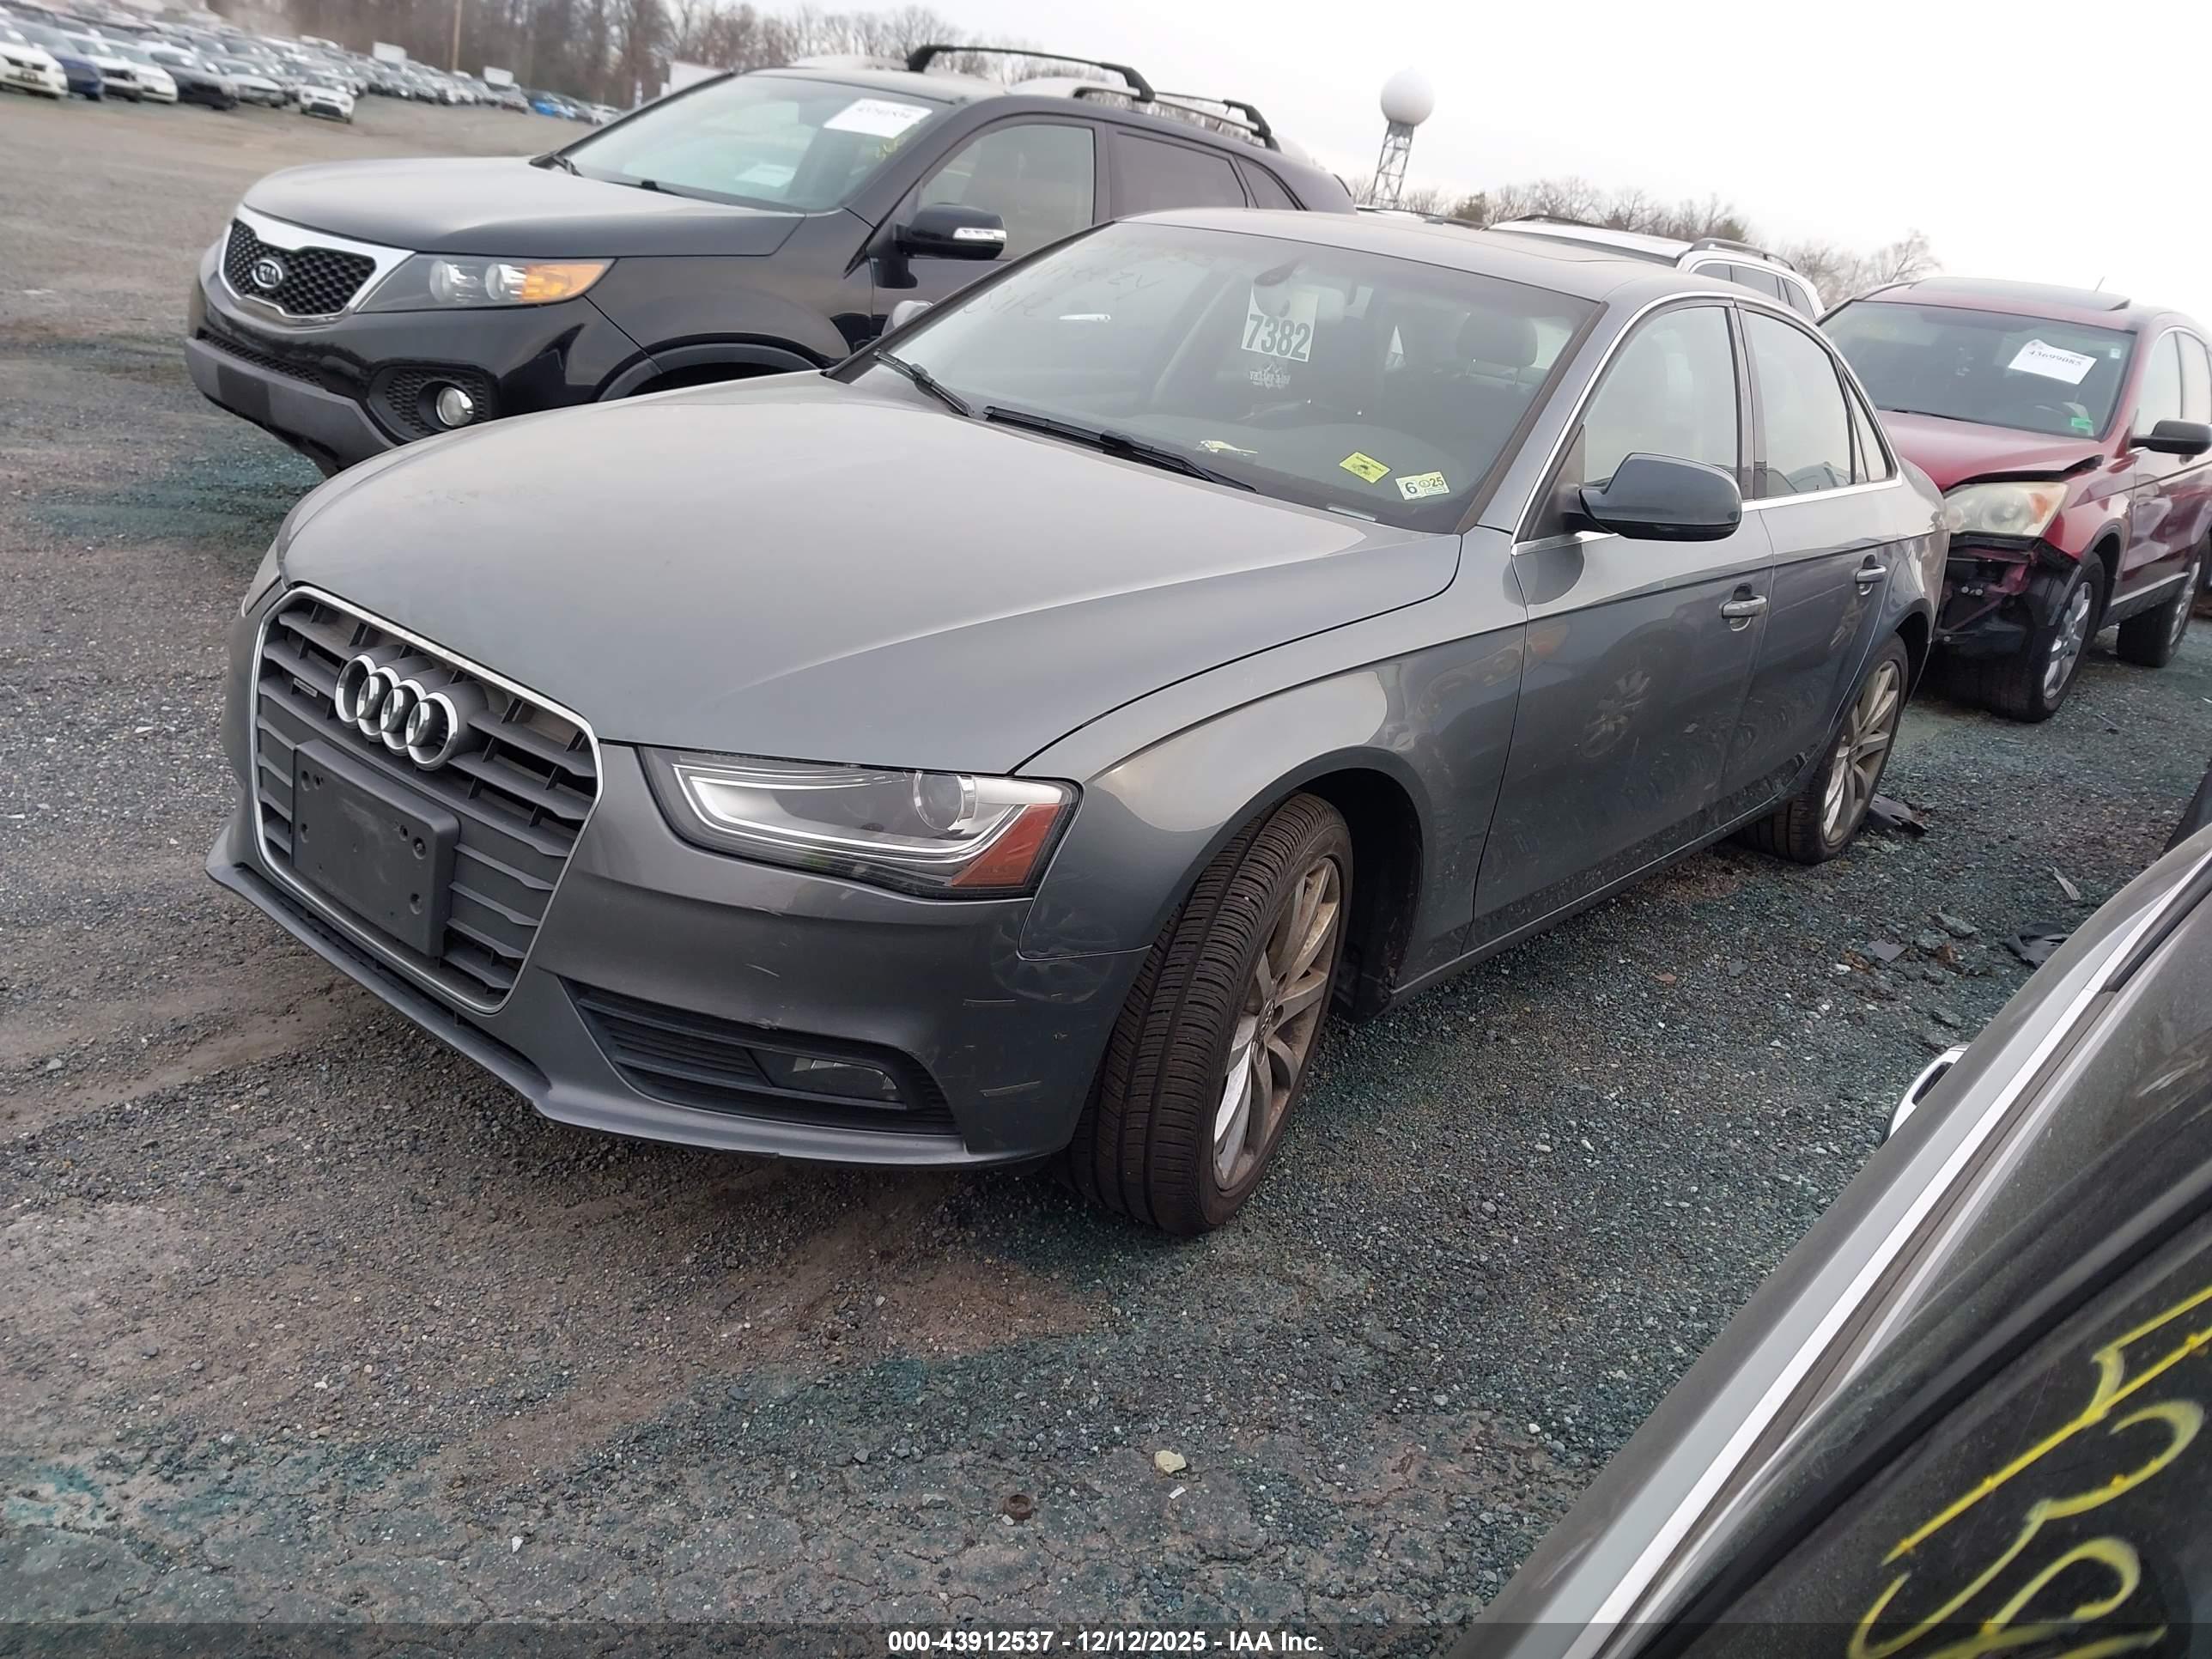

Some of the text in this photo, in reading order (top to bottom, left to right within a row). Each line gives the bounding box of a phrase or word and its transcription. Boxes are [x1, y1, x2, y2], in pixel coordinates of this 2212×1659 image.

[1247, 314, 1310, 359] 7382
[1405, 482, 1418, 494] 6
[1429, 476, 1444, 487] 25
